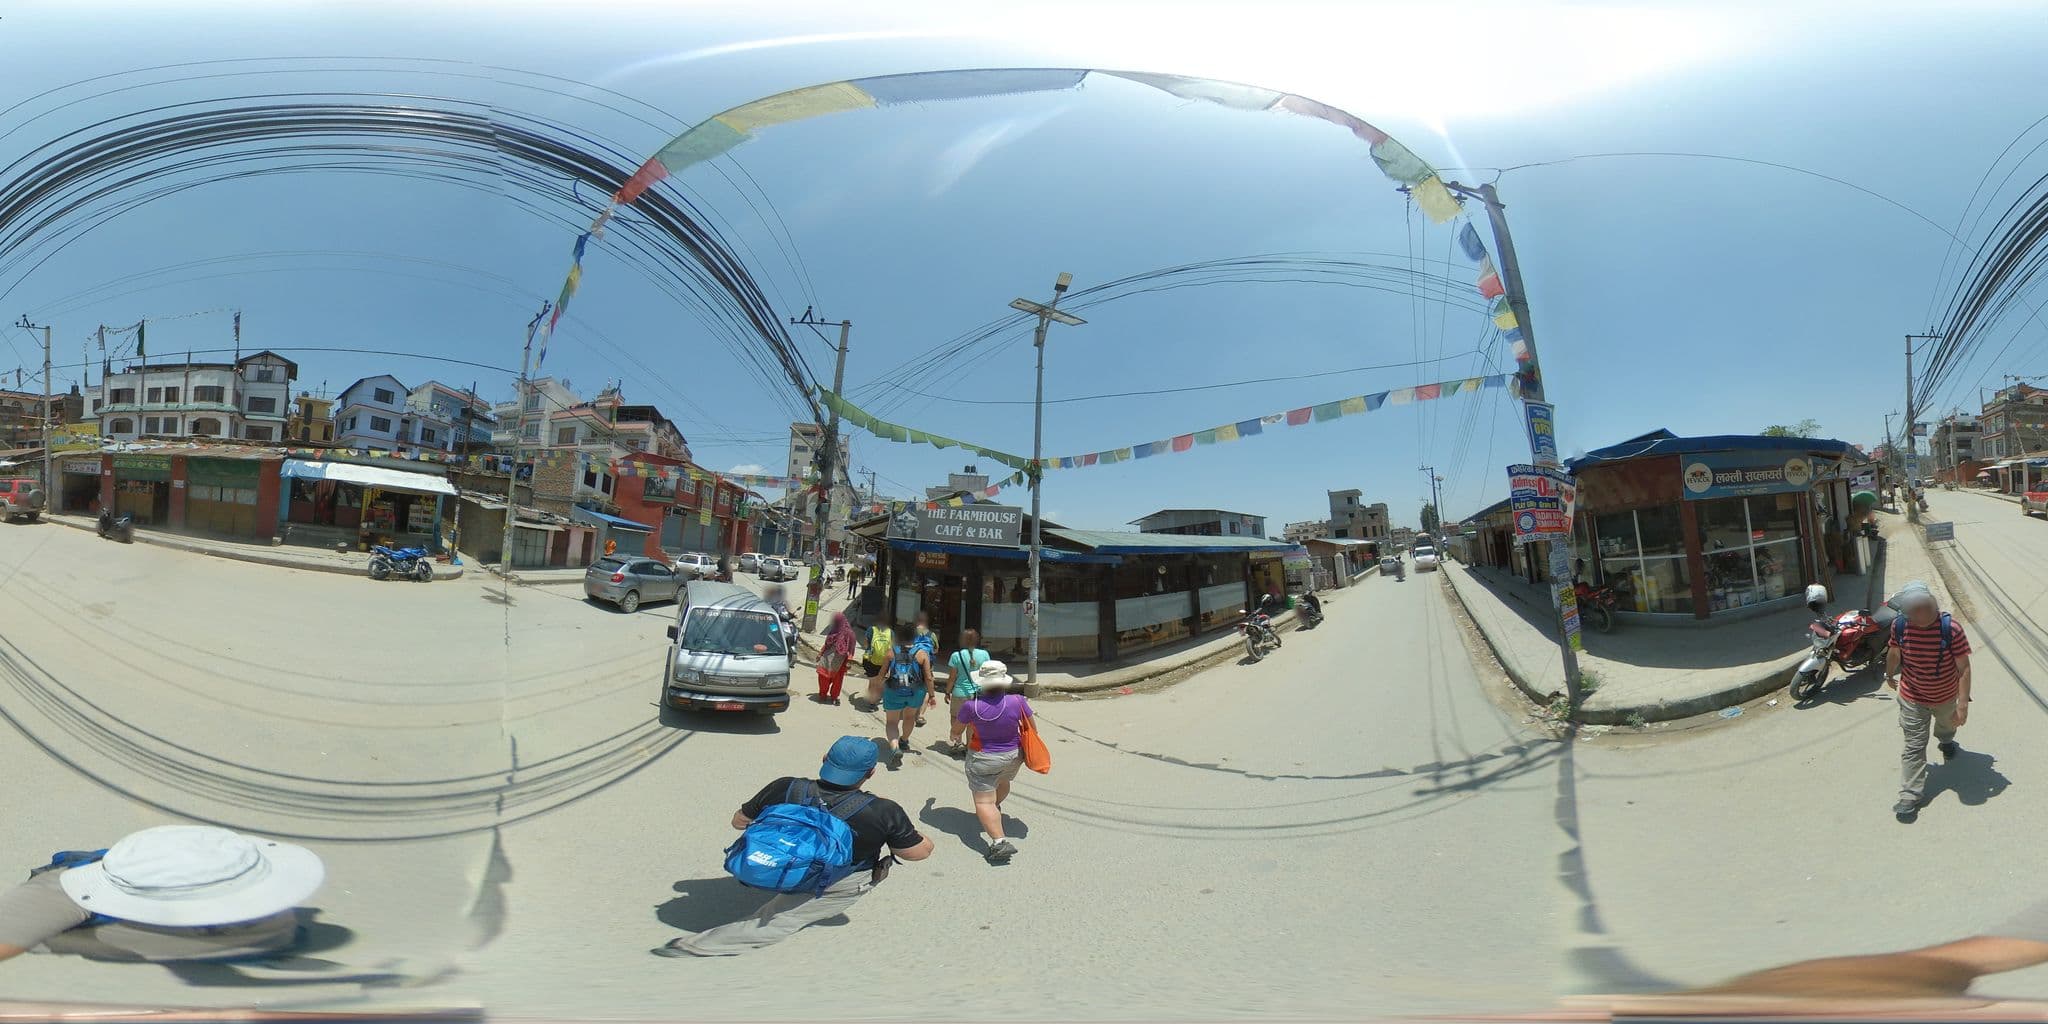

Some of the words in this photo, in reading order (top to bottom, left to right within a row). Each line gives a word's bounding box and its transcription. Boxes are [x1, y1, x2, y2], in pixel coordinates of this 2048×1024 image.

[927, 508, 947, 519] THE
[949, 508, 1017, 524] FARMHOUSE
[935, 523, 963, 536] CAFÉ
[965, 527, 977, 538] &
[978, 527, 1003, 540] BAR
